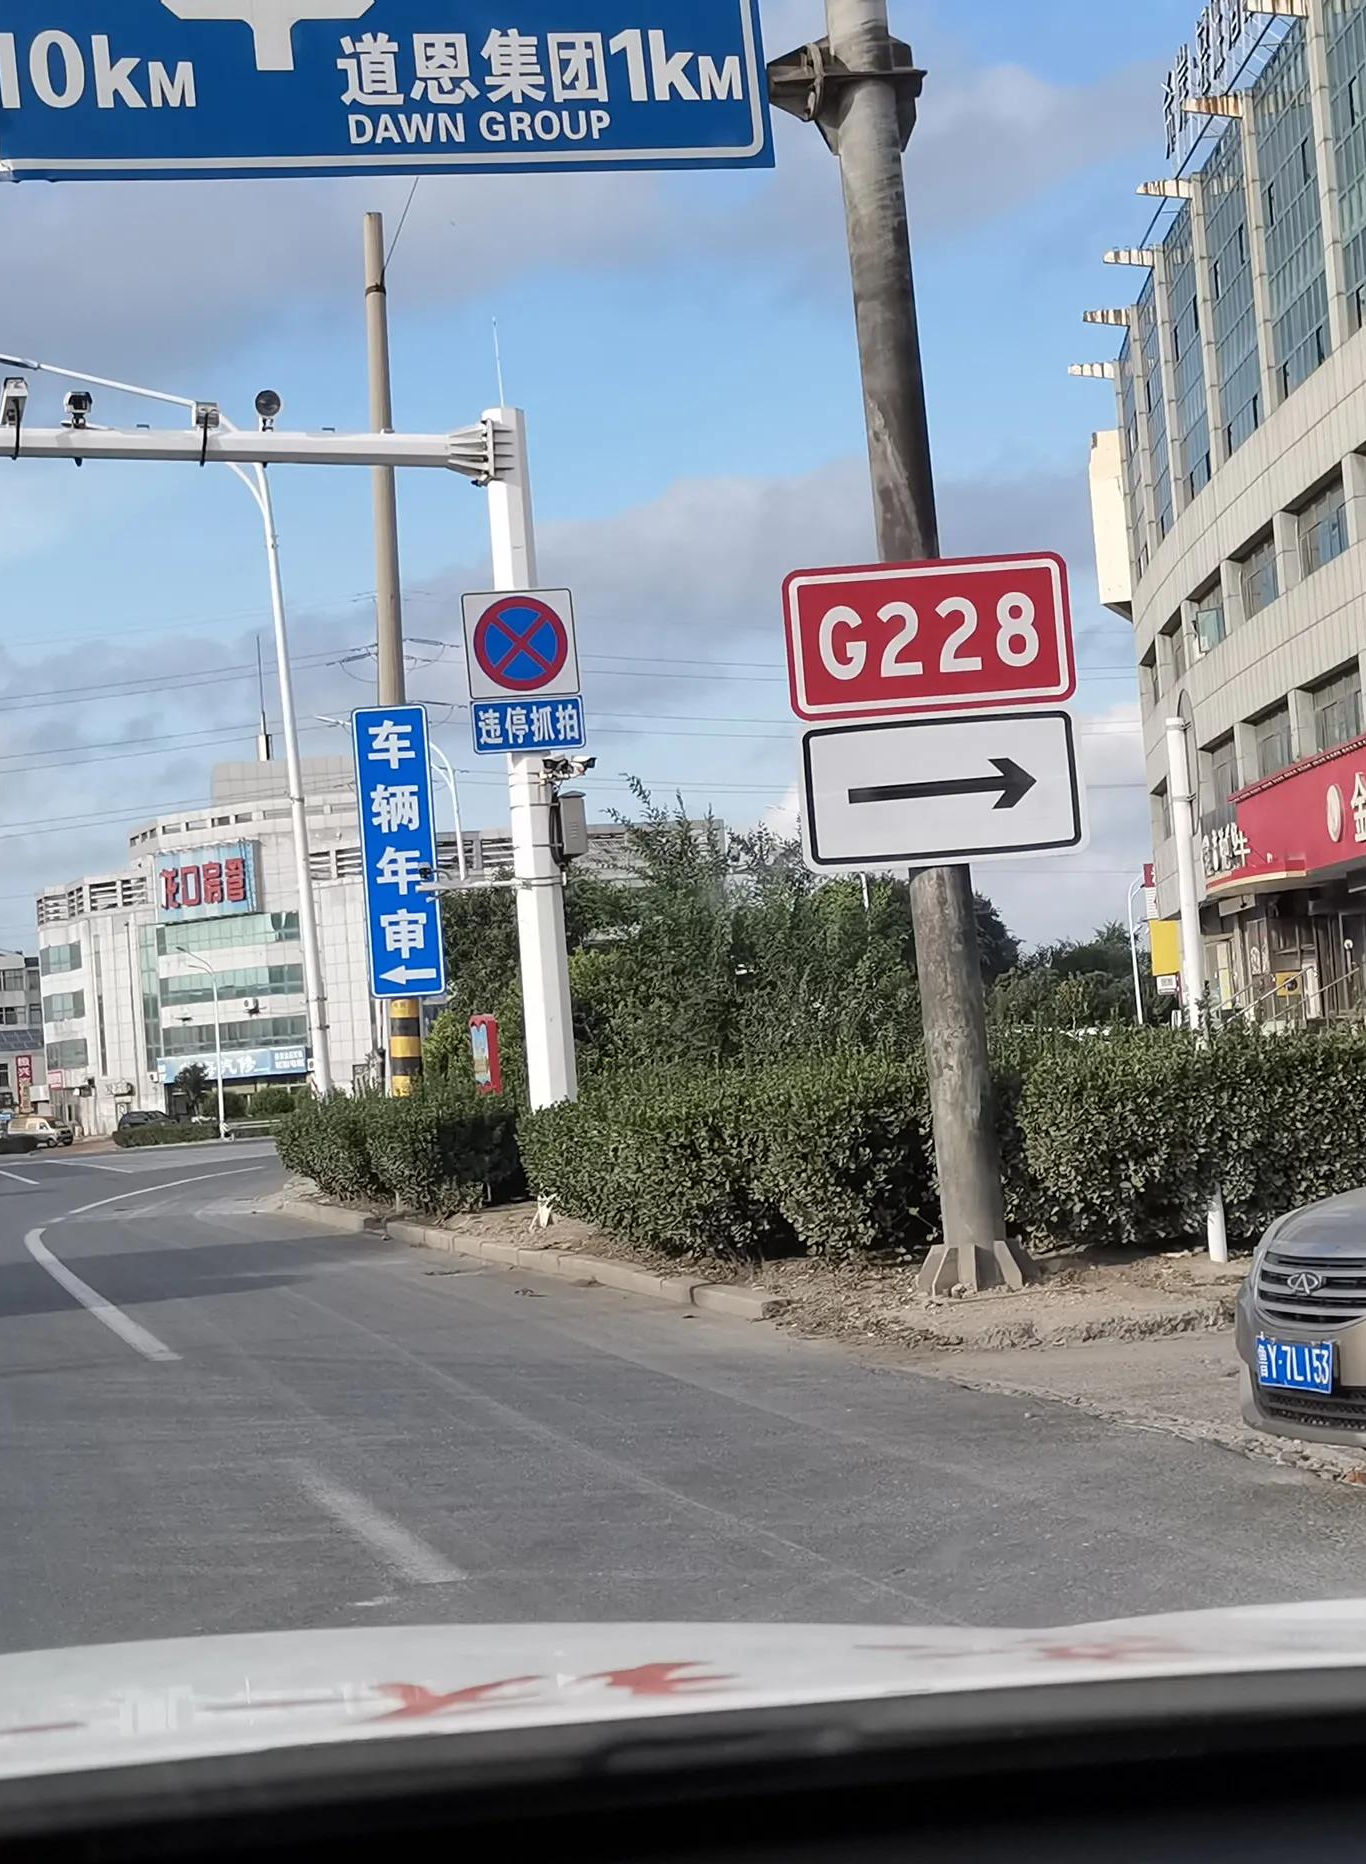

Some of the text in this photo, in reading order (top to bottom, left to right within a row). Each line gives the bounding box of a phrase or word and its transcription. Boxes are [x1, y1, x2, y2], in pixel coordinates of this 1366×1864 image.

[348, 109, 611, 144] DAWN GROUP
[818, 591, 1040, 681] G228
[478, 704, 580, 744] 违停抓拍
[367, 719, 428, 960] 车辆年审
